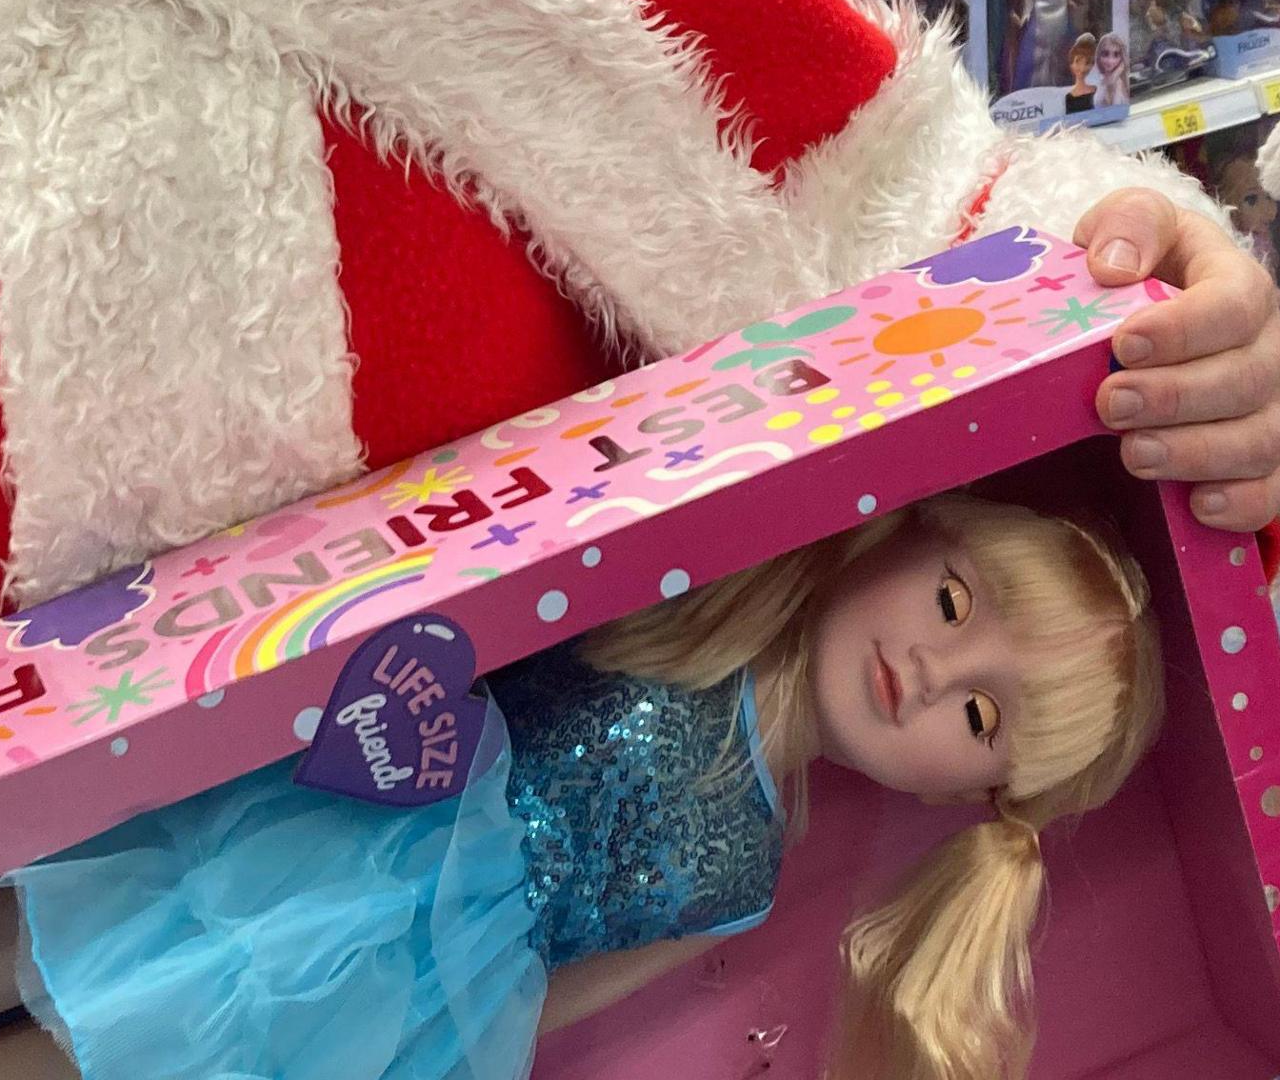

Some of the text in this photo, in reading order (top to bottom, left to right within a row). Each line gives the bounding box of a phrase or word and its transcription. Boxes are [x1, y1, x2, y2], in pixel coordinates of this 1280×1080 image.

[992, 104, 1045, 124] FROZEN
[588, 358, 830, 471] BEST
[84, 466, 553, 670] FRIENDS
[335, 692, 415, 792] friend
[372, 644, 460, 790] LIFE SIZE
